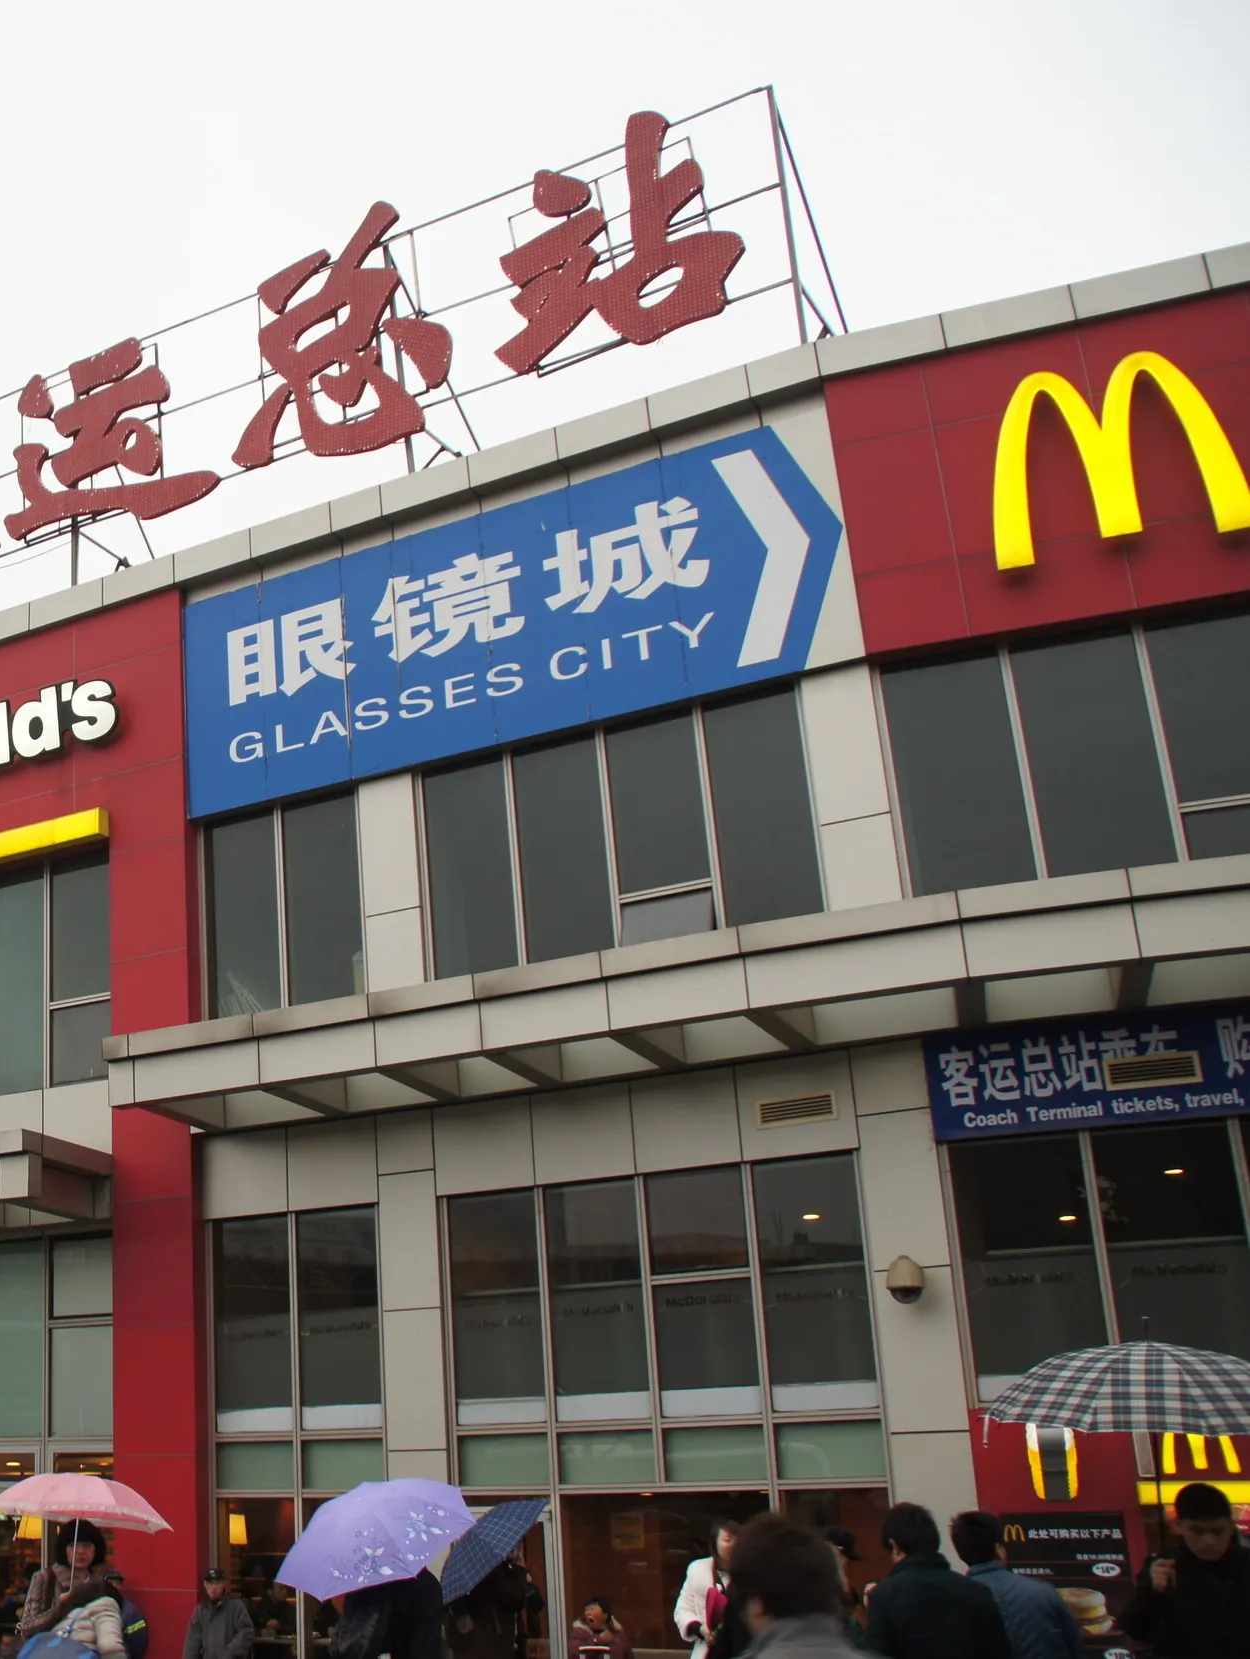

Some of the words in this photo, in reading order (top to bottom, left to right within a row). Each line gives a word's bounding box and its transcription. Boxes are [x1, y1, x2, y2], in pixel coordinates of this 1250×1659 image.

[226, 496, 711, 706] 眼镜城
[228, 661, 525, 763] GLASSES
[549, 611, 716, 681] CITY
[963, 1108, 1019, 1128] Coach
[1026, 1101, 1103, 1123] Terminal
